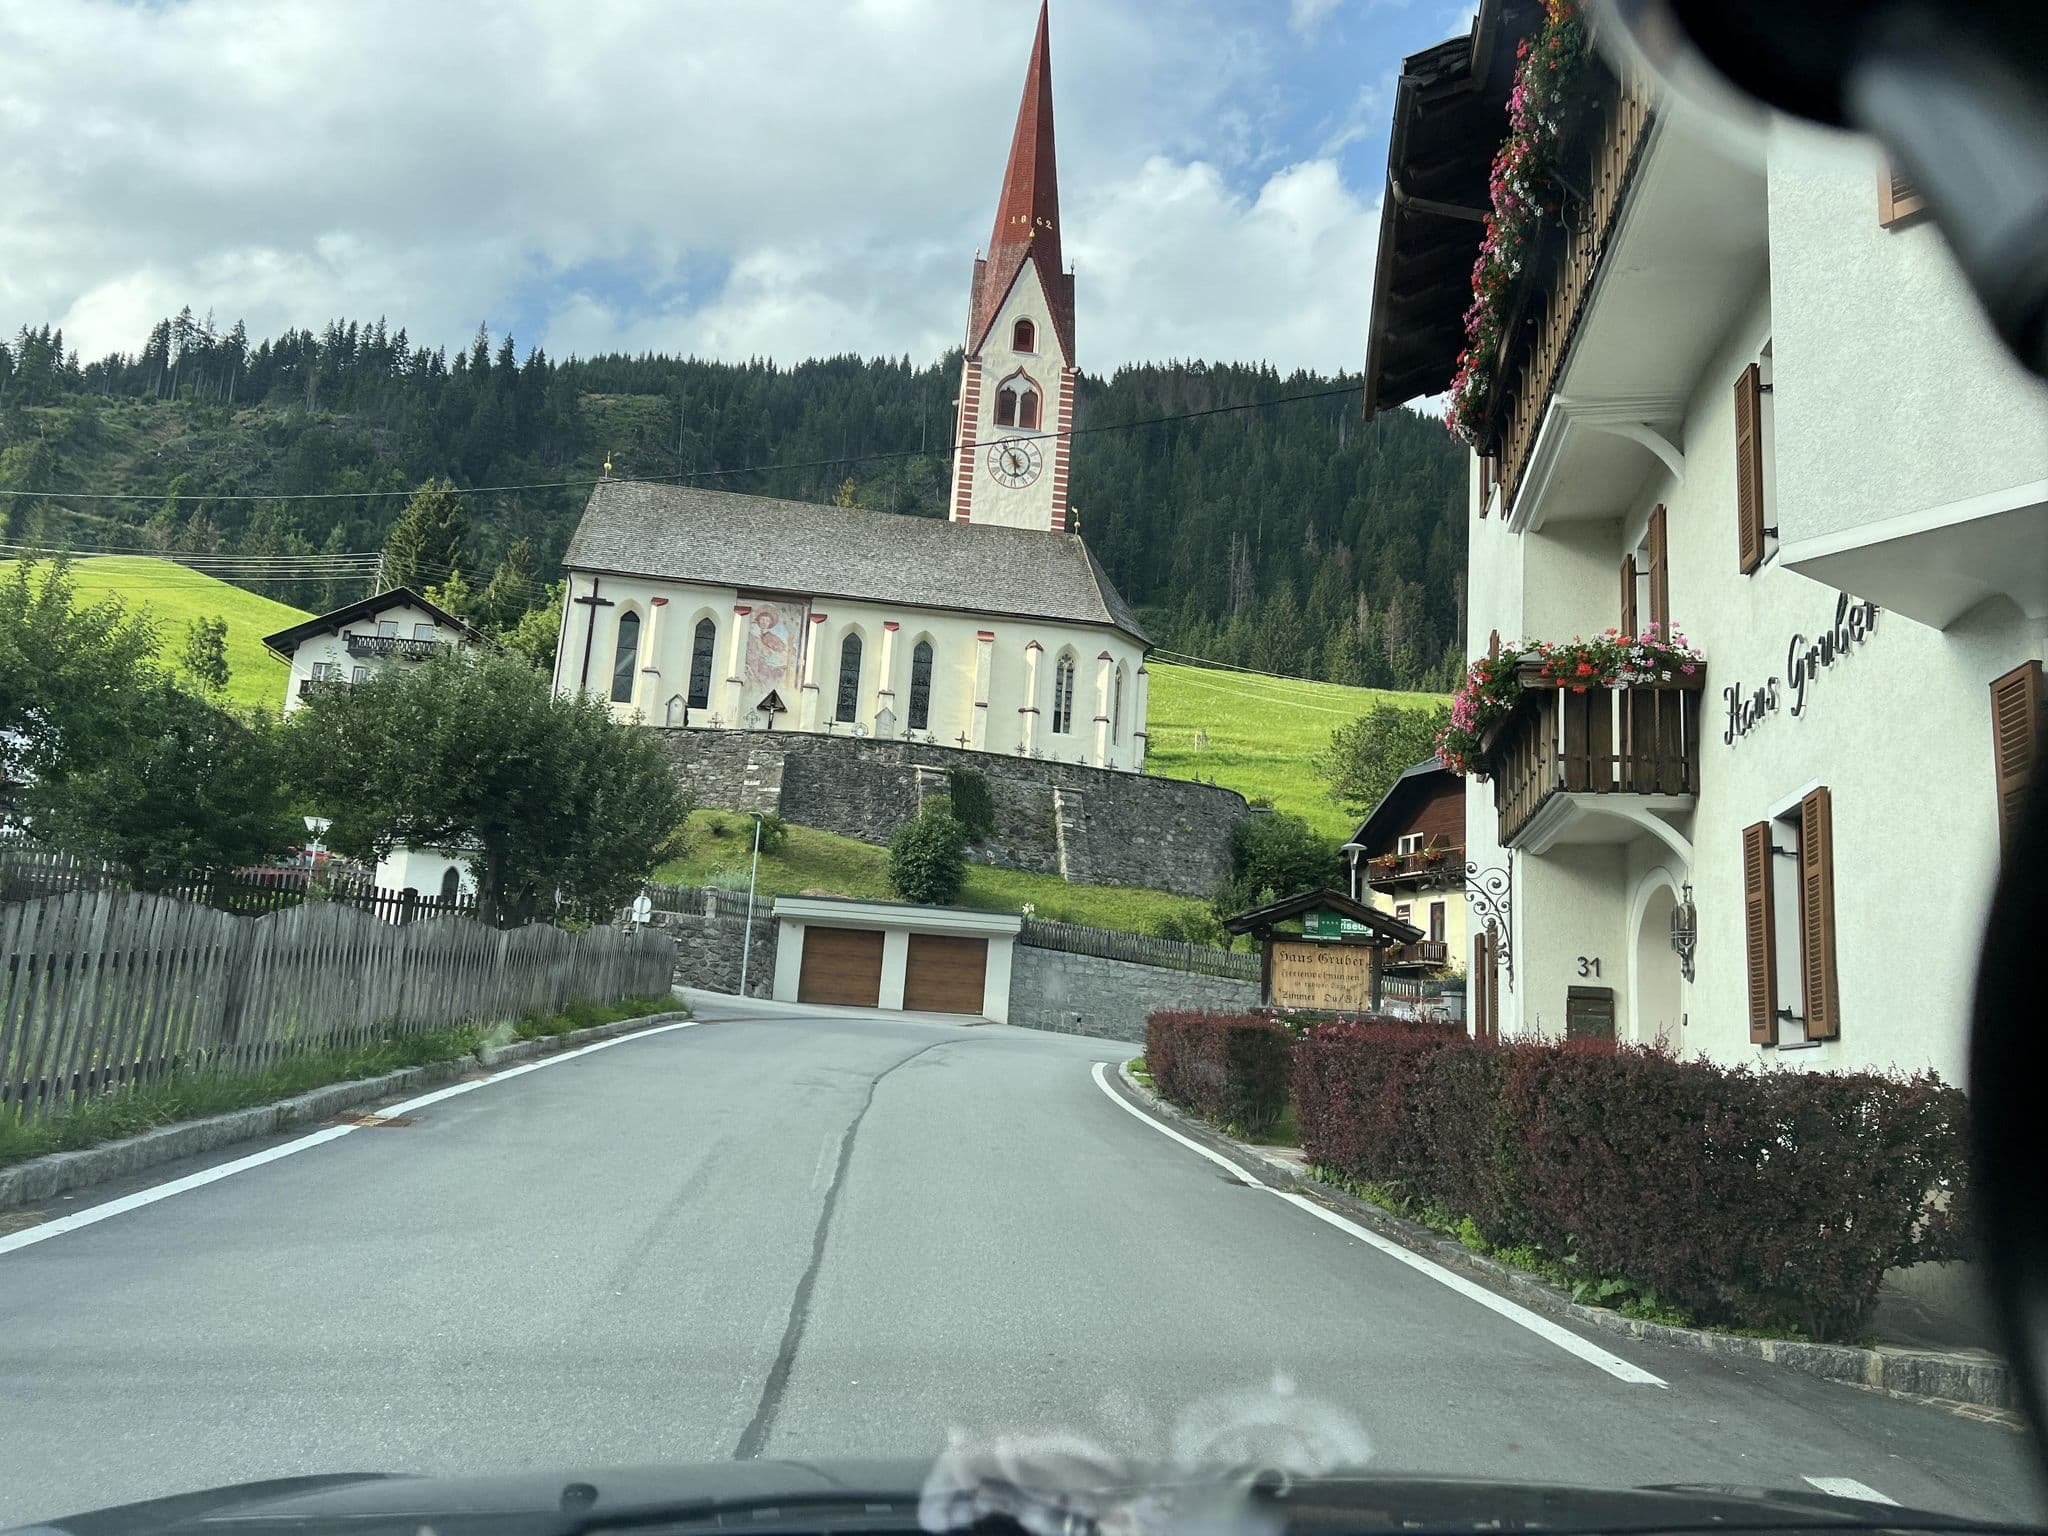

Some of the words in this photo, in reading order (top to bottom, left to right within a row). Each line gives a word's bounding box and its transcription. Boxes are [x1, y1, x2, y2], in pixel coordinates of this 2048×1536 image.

[1723, 677, 1778, 745] Haus
[1788, 592, 1880, 717] Gruber
[1341, 920, 1366, 930] riseur
[1279, 951, 1313, 963] Haus
[1318, 952, 1364, 966] Gruber
[1577, 956, 1600, 978] 31
